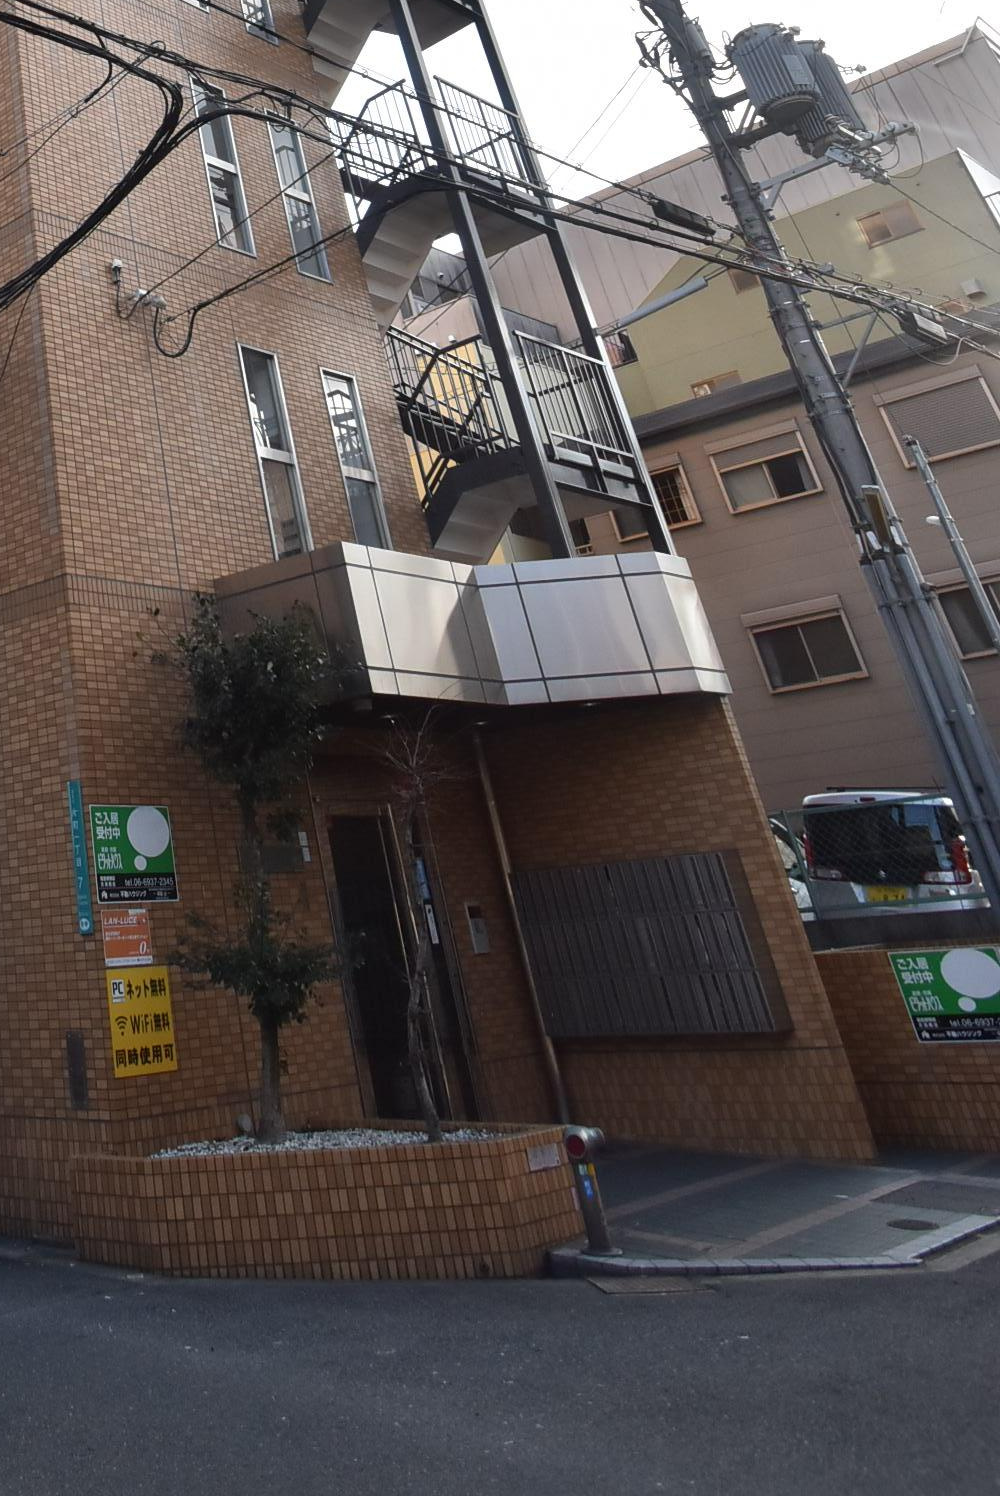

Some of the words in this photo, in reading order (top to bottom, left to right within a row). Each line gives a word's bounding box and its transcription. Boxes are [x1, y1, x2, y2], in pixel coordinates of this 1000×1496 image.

[94, 811, 120, 825] ご入居
[96, 826, 121, 841] 受付中
[896, 957, 930, 971] ご入居
[901, 971, 935, 985] 受付中
[111, 981, 124, 996] PC
[126, 978, 167, 1001] ネット無料
[129, 1011, 171, 1035] WiFi無料
[115, 1044, 175, 1069] 同時使用可
